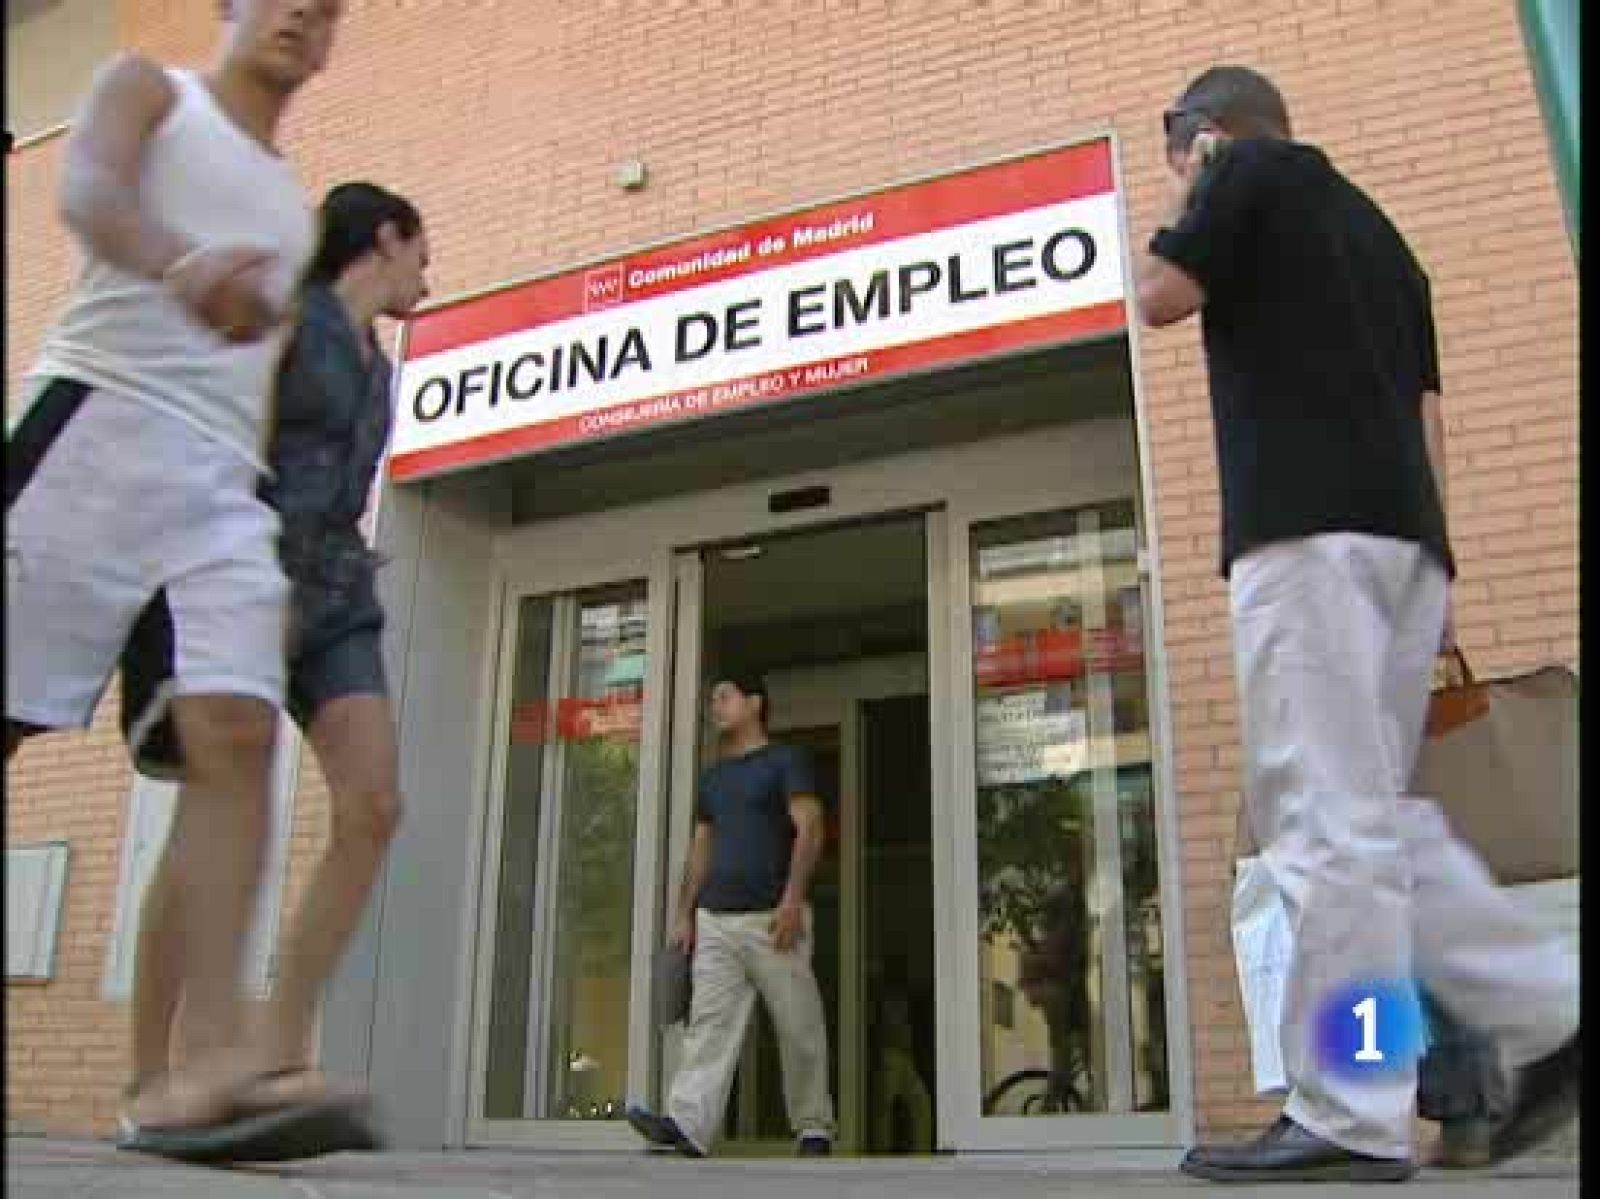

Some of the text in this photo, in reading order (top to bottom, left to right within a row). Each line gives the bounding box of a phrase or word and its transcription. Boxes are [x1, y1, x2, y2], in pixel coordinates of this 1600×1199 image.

[628, 211, 875, 289] Comunidad de Madrid
[413, 227, 1098, 423] OFICINA DE EMPLEO
[686, 389, 709, 410] DE
[712, 373, 784, 405] EMPLEO
[788, 371, 802, 387] Y
